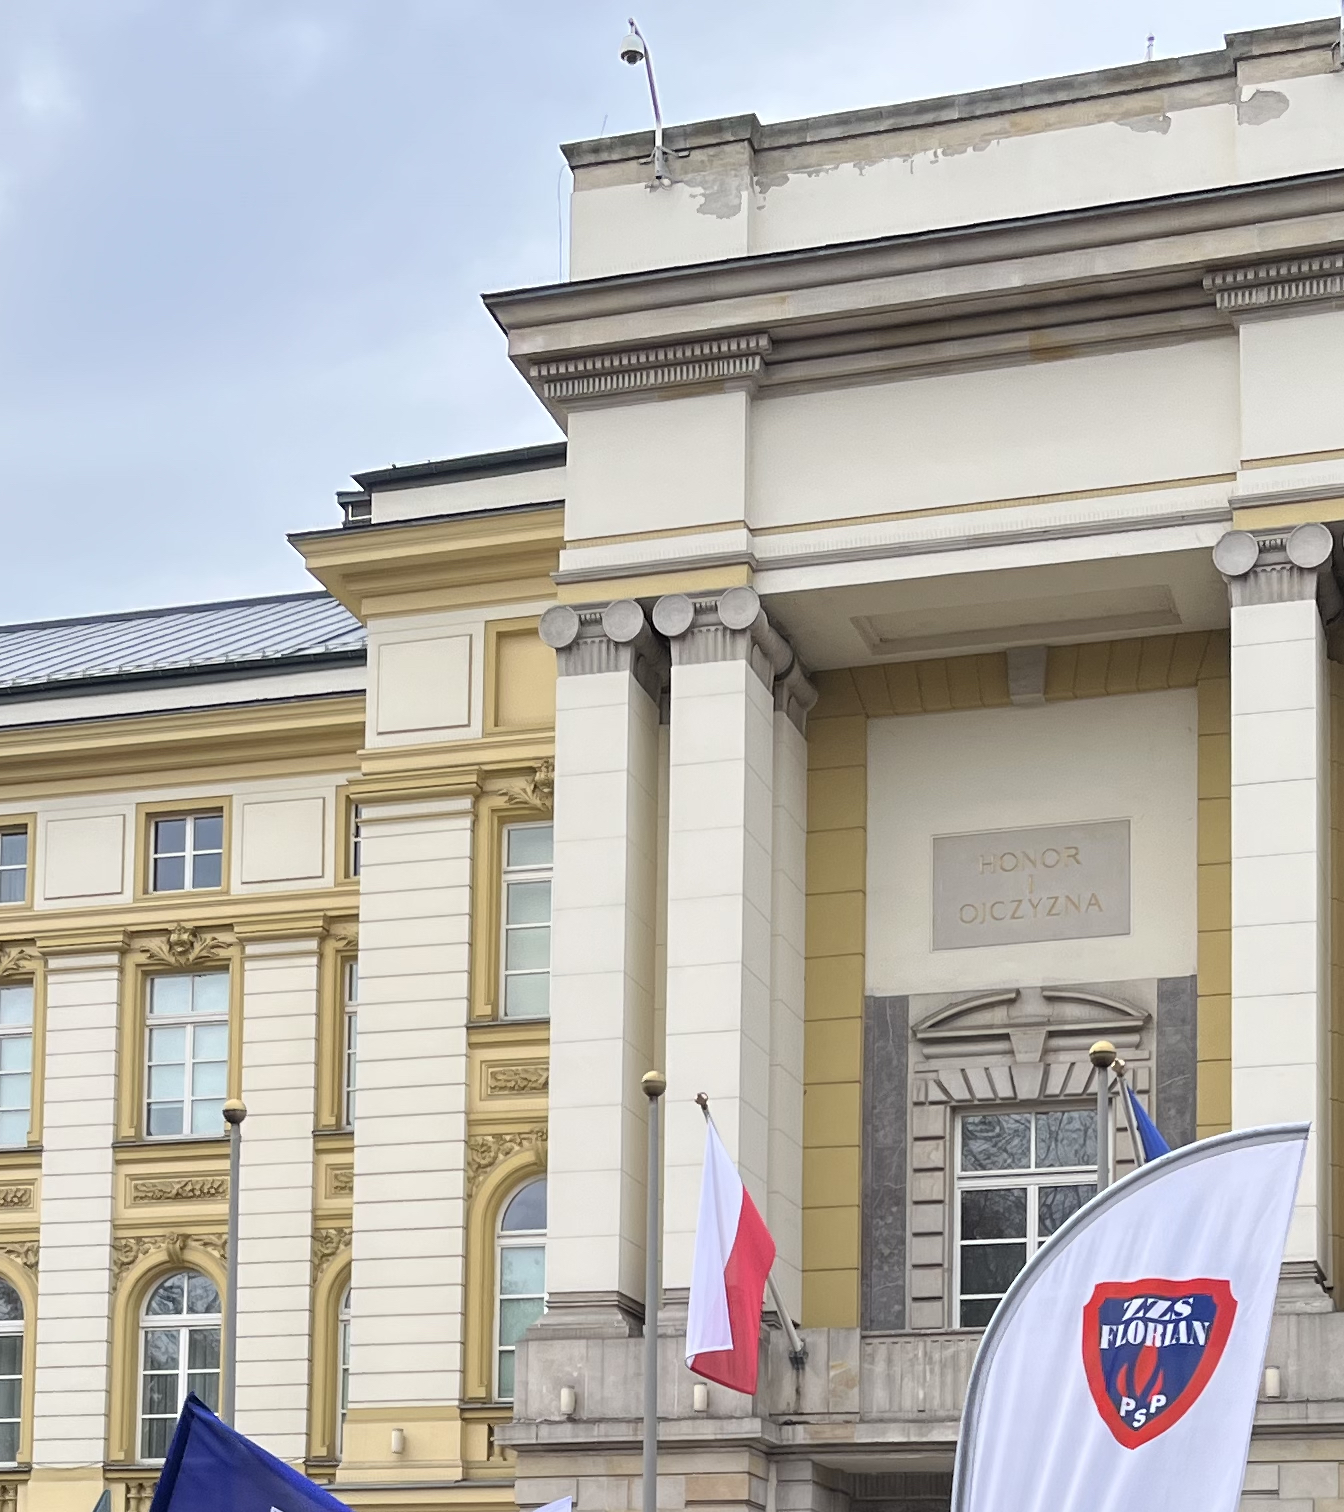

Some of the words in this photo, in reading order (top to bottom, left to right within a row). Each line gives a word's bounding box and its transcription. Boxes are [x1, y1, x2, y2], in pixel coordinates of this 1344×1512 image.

[979, 846, 1083, 875] HONOR
[1027, 873, 1036, 895] I
[959, 892, 1103, 925] OJCZYZNA
[1122, 1298, 1194, 1321] ZZS
[1099, 1320, 1210, 1350] FLORIAN
[1120, 1395, 1166, 1428] PSP
